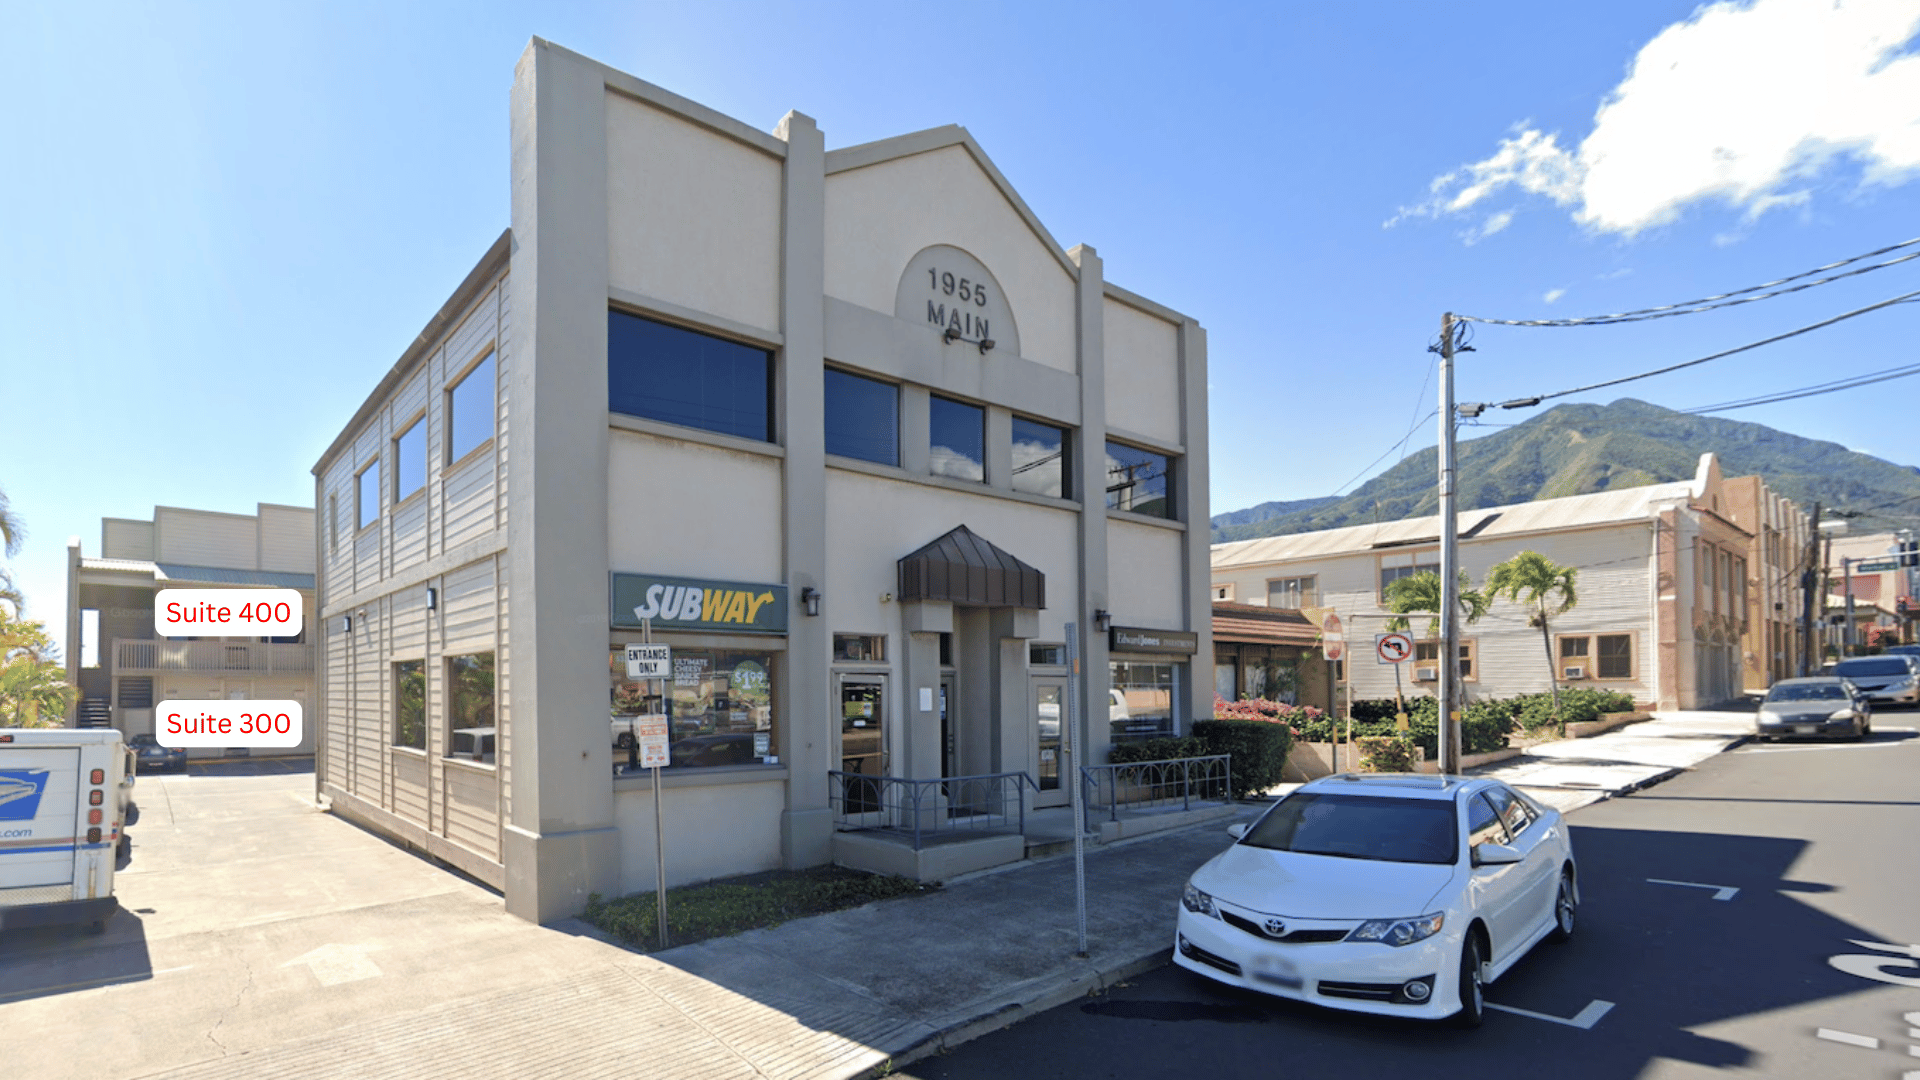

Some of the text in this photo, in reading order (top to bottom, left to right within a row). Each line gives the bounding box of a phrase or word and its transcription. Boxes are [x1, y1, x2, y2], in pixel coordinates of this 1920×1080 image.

[928, 268, 986, 306] 1955
[927, 300, 988, 340] MAIN
[634, 584, 775, 625] SUBWAY
[628, 648, 668, 660] ENTRANCE
[674, 658, 708, 667] ULTIMATE
[639, 662, 657, 673] ONLY
